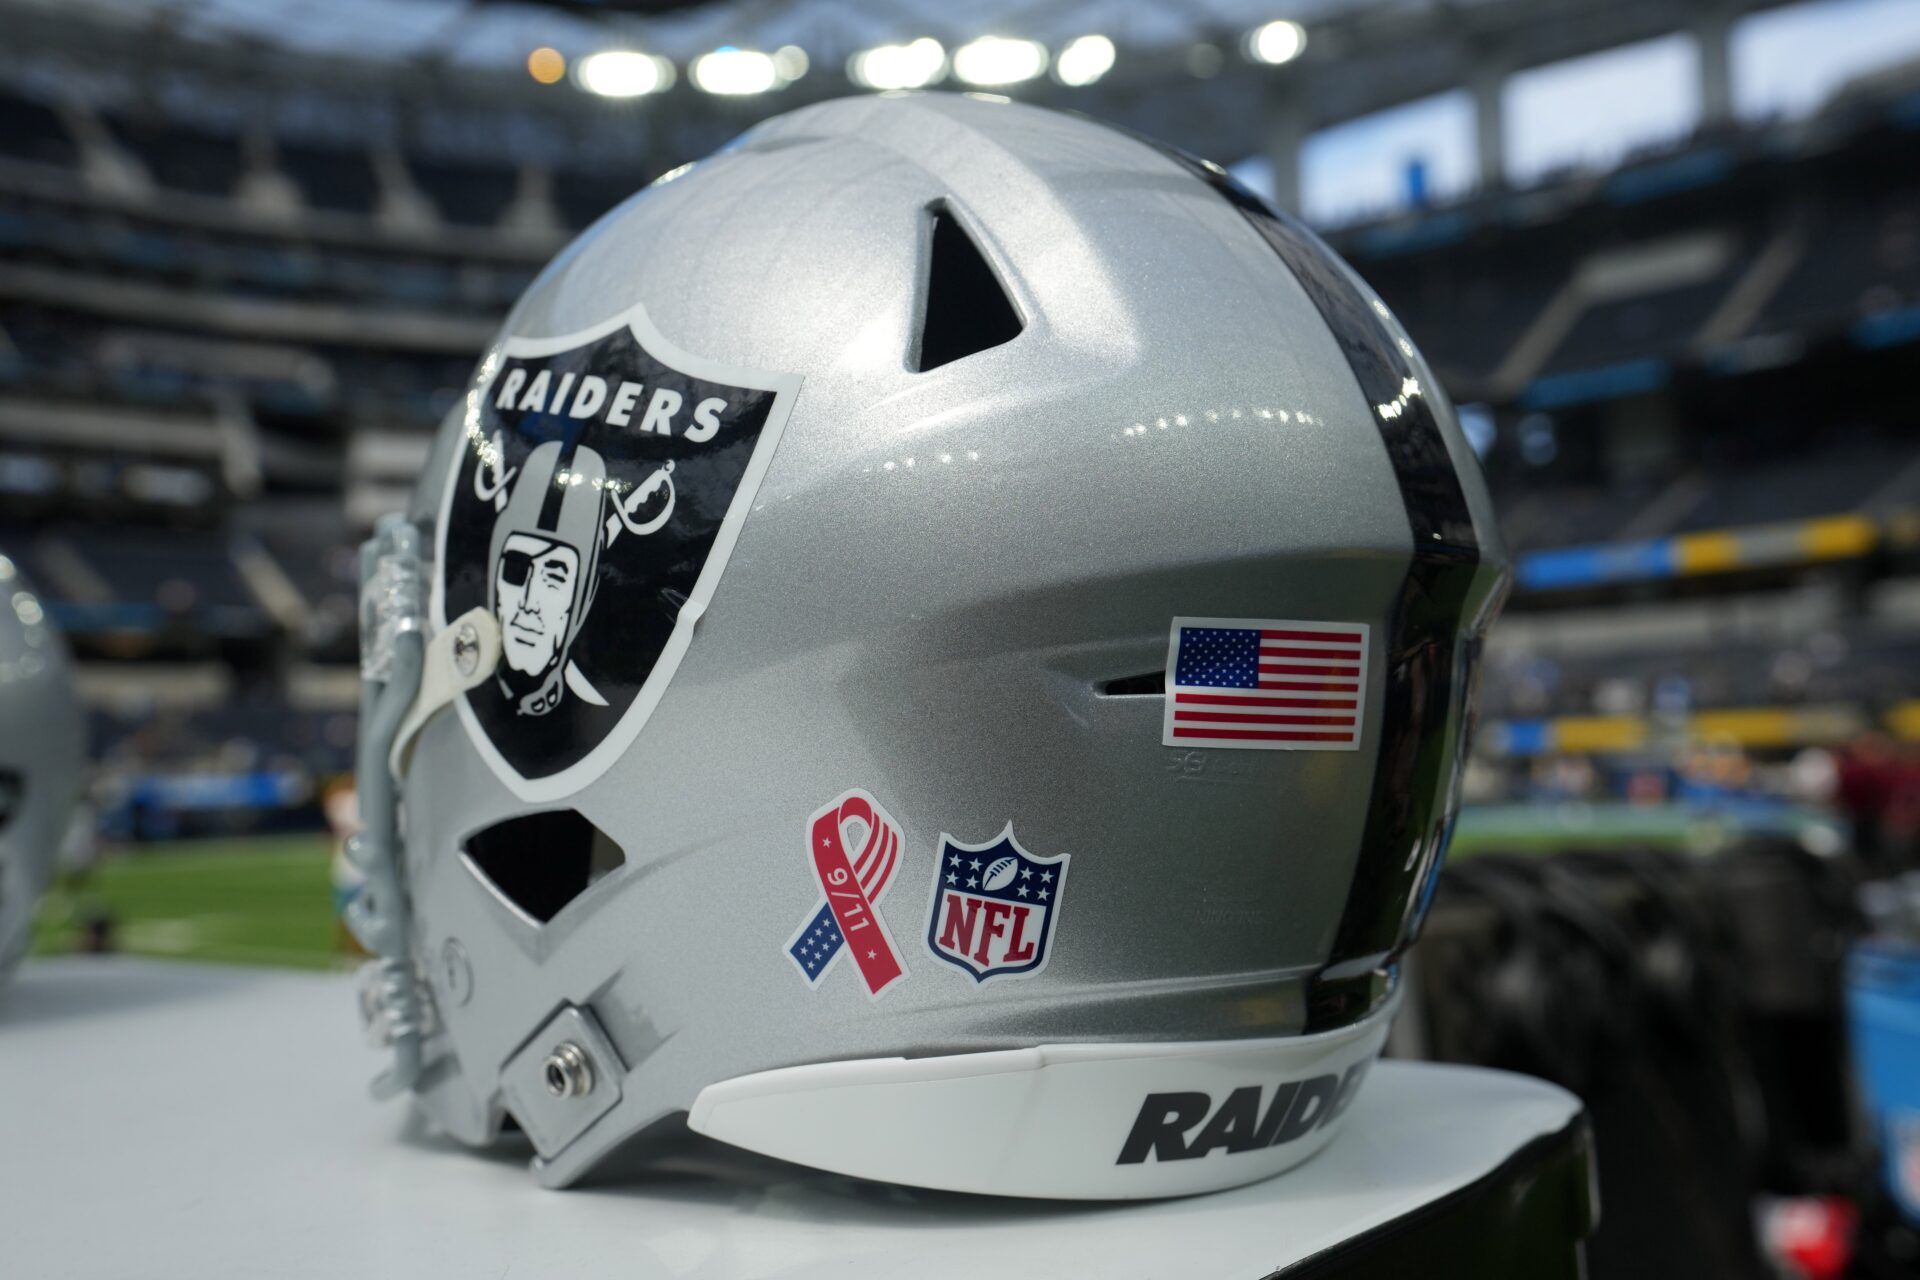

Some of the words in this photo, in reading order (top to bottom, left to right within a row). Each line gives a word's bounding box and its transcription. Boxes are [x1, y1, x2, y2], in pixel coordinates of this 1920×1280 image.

[495, 368, 728, 443] RAIDERS
[827, 867, 870, 932] 9/11
[938, 894, 1035, 967] NFL
